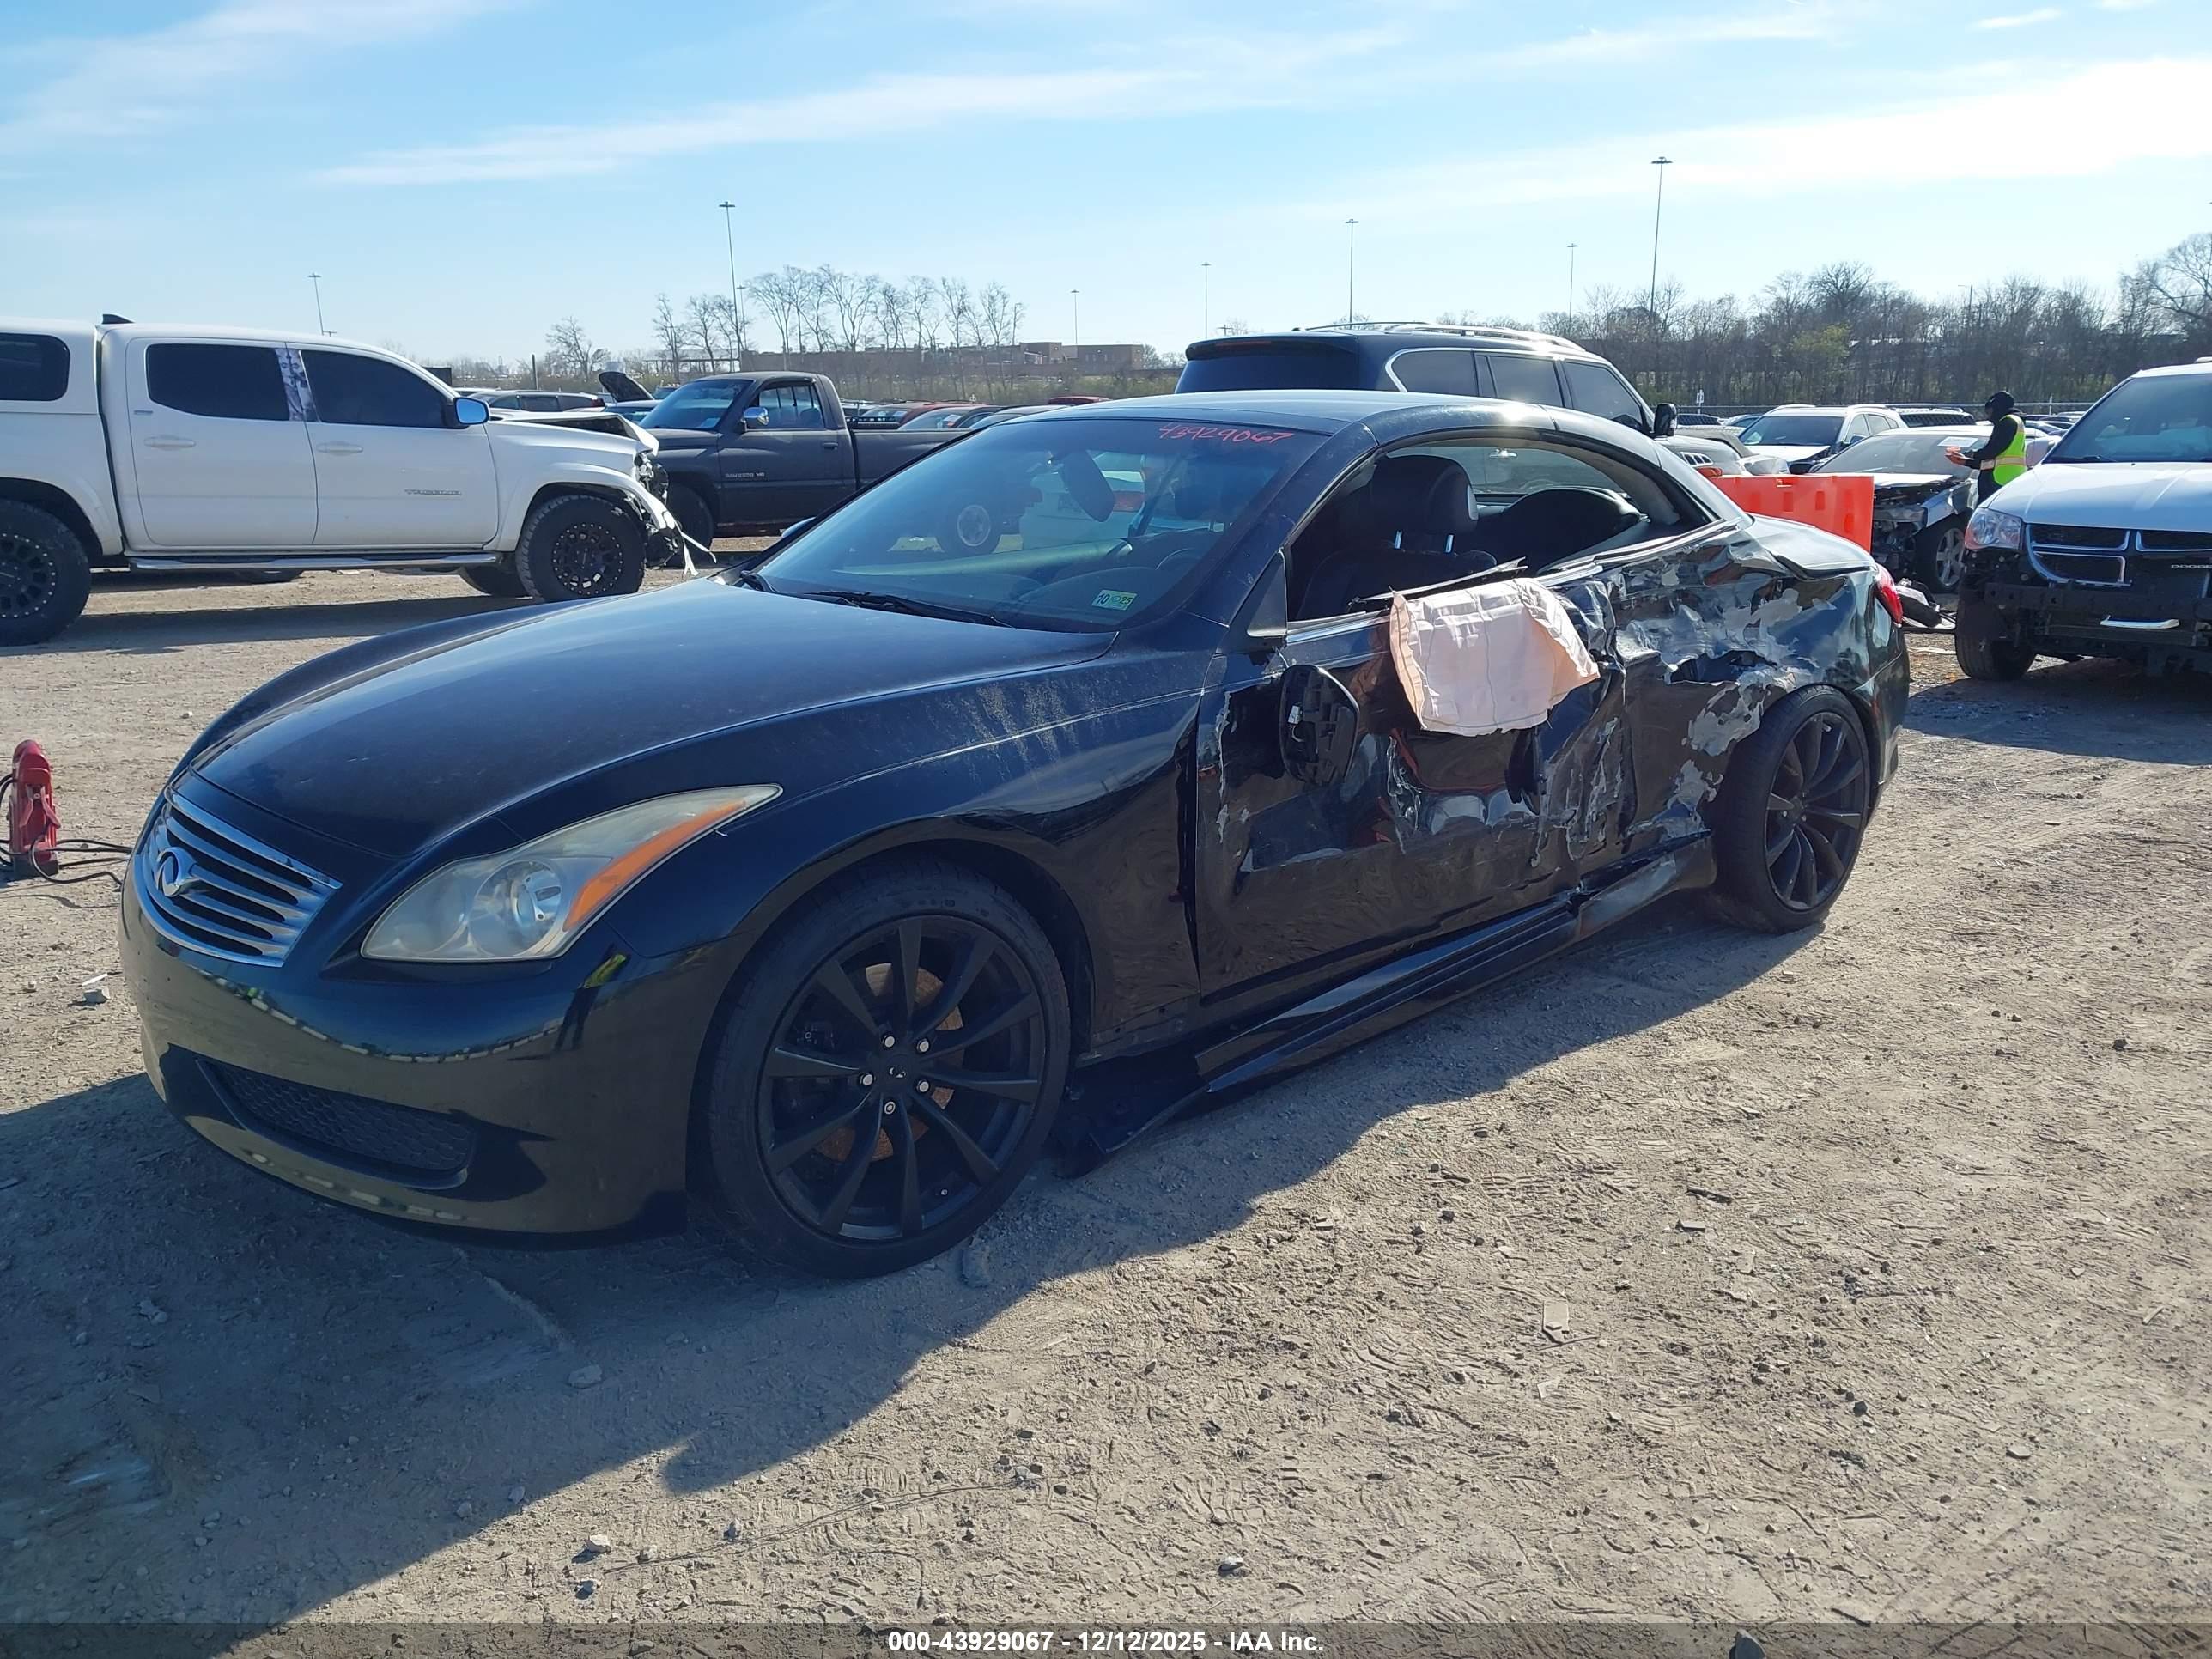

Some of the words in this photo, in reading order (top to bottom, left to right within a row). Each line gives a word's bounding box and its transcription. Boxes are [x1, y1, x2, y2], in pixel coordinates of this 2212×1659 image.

[1159, 422, 1295, 443] 43929067
[1097, 593, 1110, 605] 10
[1120, 596, 1133, 605] 25
